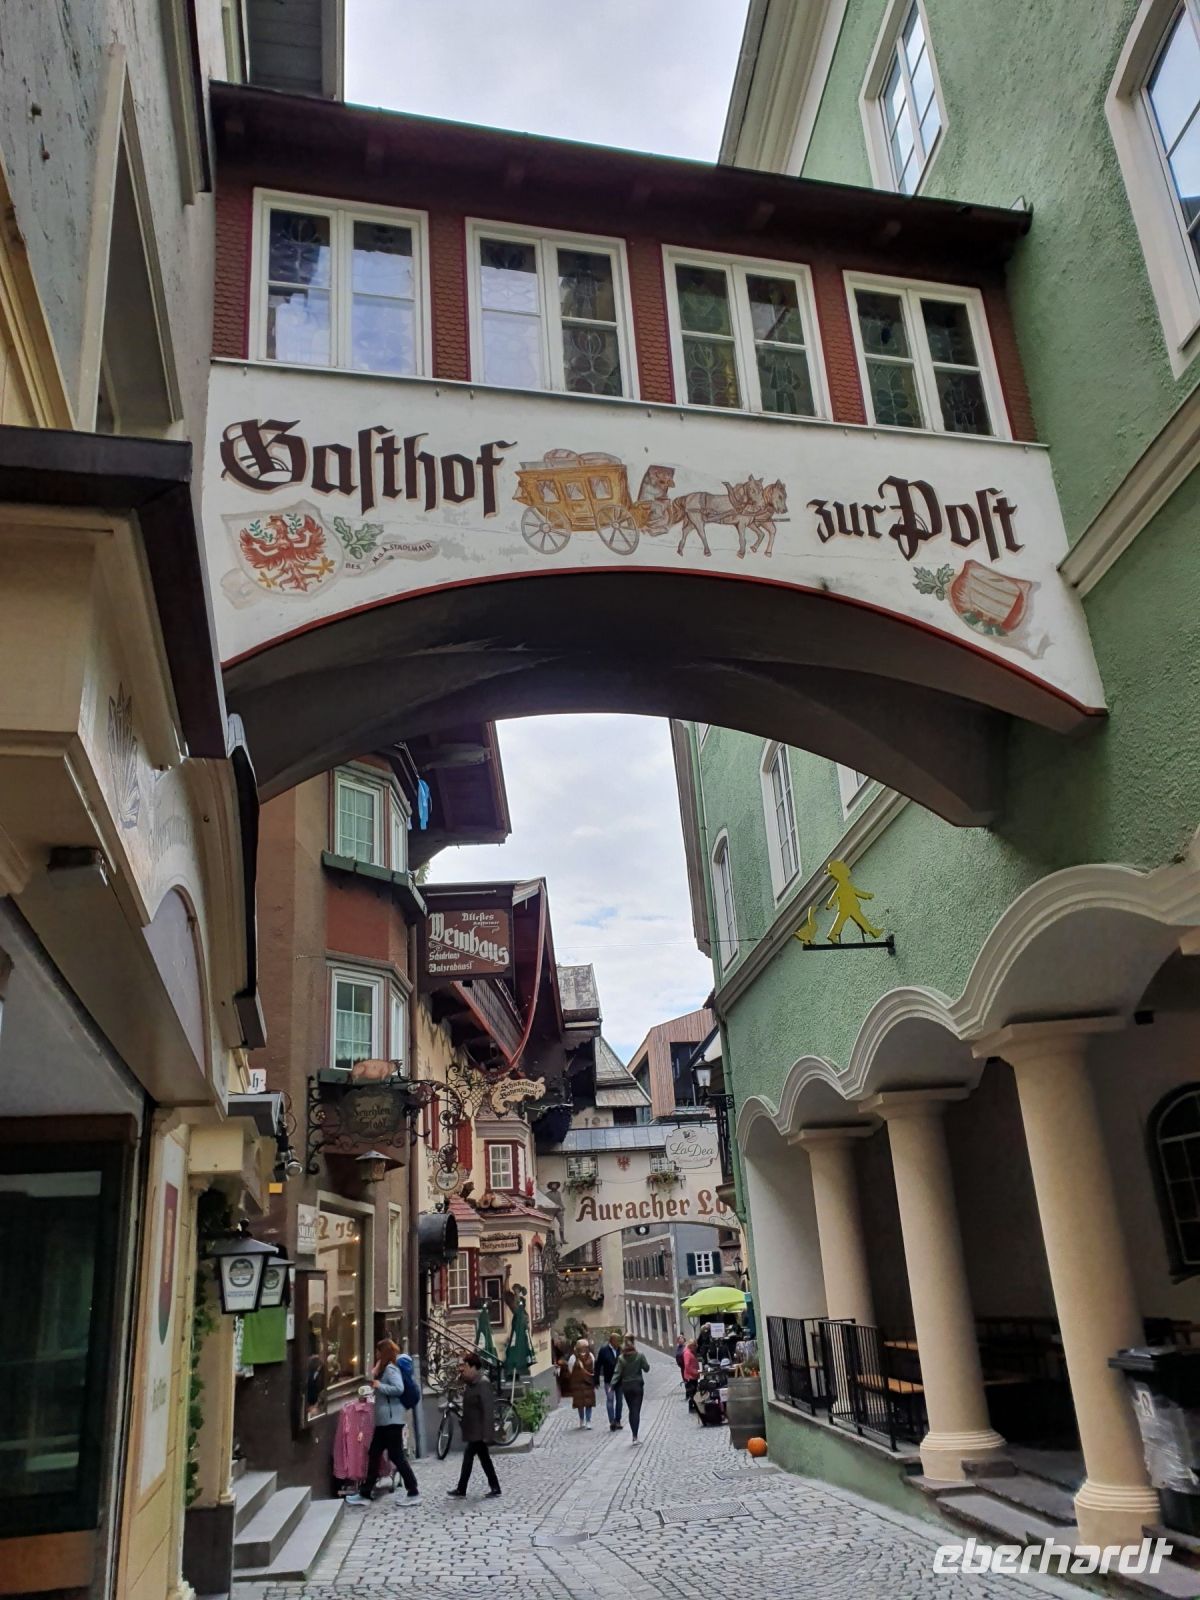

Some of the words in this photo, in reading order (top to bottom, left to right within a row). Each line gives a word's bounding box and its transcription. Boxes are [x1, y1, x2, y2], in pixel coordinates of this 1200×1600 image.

[220, 418, 518, 519] Gasthof
[806, 499, 886, 544] zur
[878, 475, 1025, 562] Post
[428, 912, 510, 965] Weinhaus
[575, 1192, 690, 1223] Auracher
